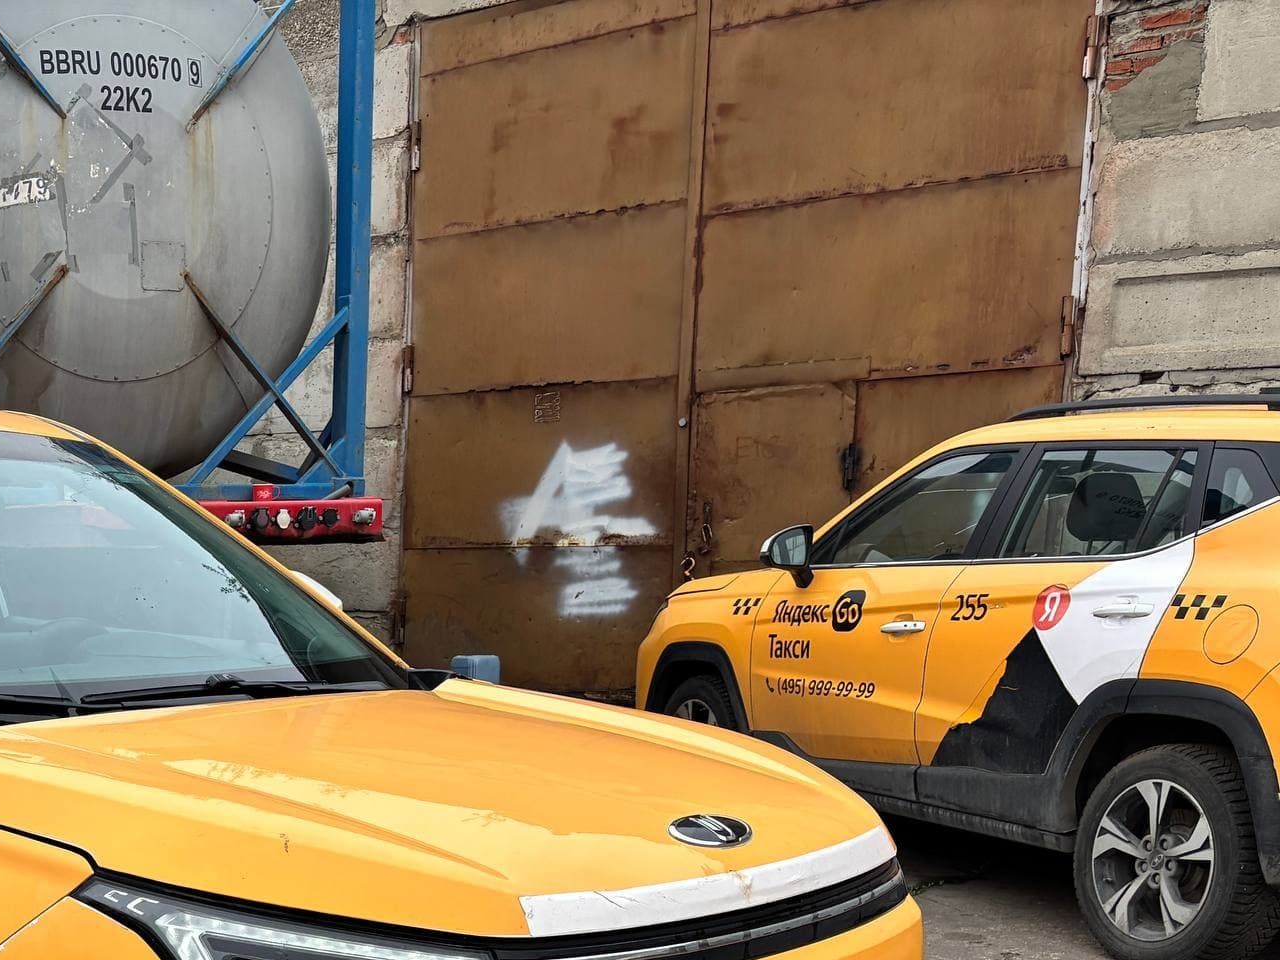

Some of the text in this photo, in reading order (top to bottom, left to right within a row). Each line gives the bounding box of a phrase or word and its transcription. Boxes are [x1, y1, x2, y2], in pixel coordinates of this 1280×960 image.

[39, 49, 201, 86] BBRU 000670 9
[100, 85, 153, 114] 22K2
[771, 597, 860, 627] Яндекс Go
[950, 593, 990, 622] 255
[1038, 590, 1061, 623] Я
[768, 633, 811, 659] Такси
[777, 677, 876, 699] (495) 999-99-99
